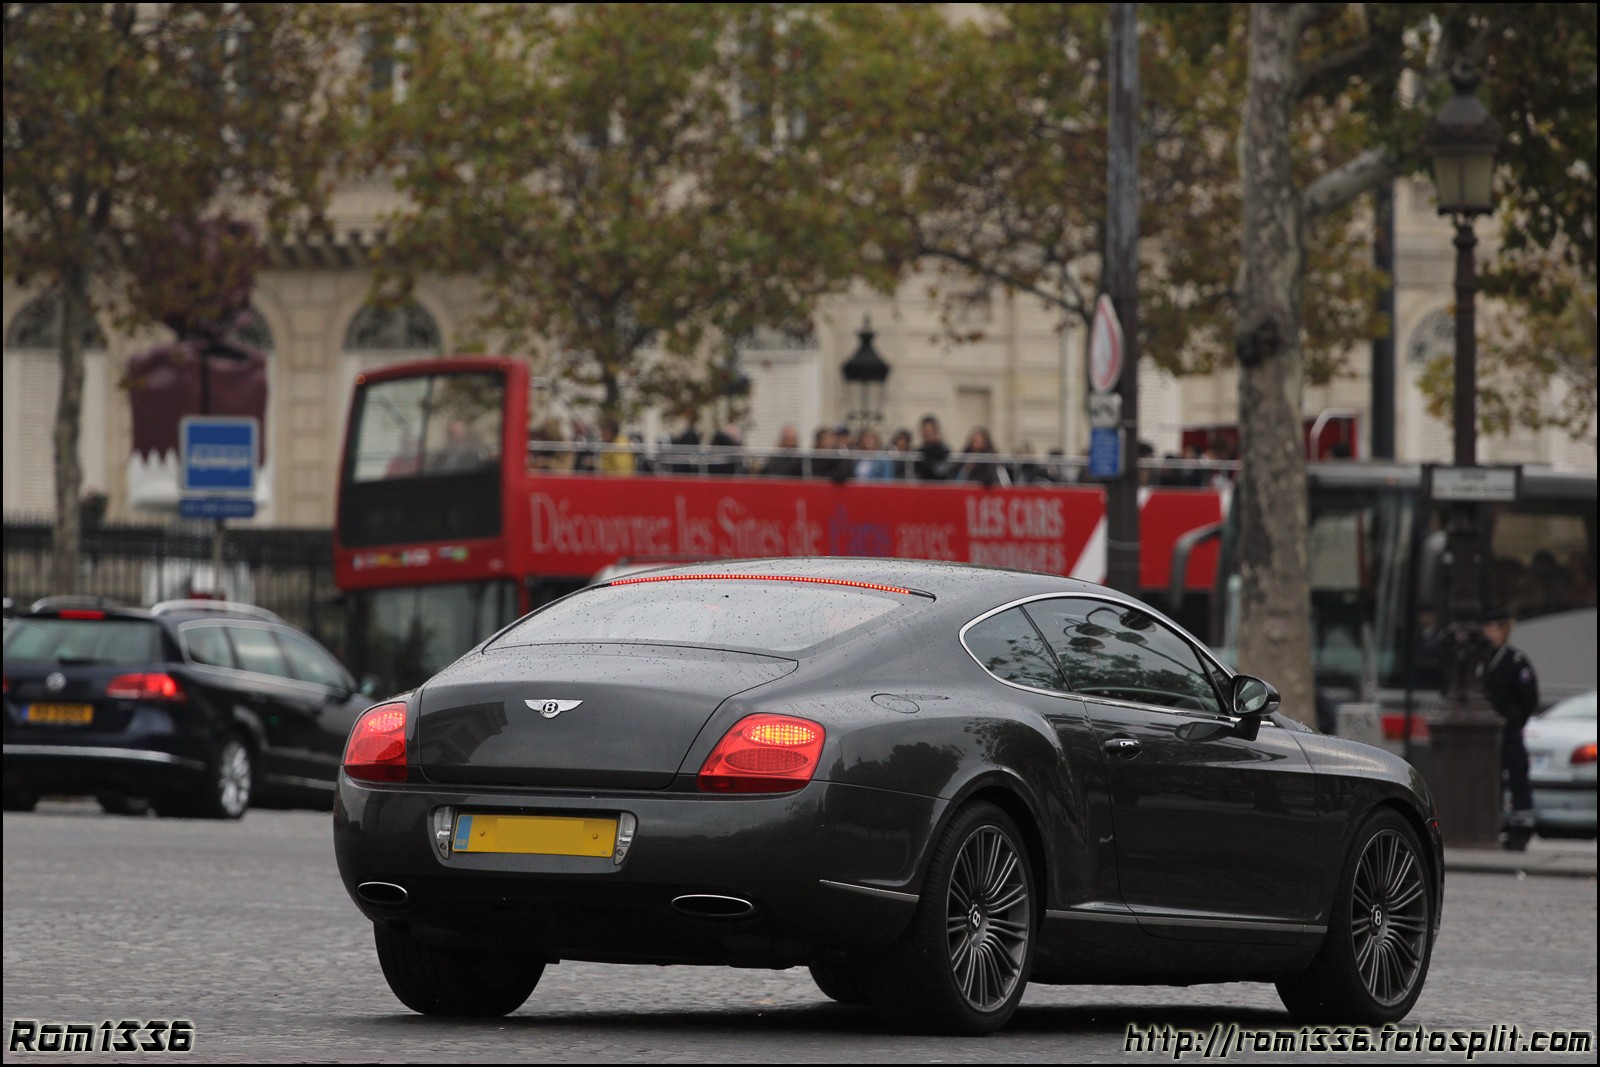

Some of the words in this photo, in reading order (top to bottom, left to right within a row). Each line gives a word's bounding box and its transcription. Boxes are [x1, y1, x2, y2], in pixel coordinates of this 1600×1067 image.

[787, 498, 822, 556] de
[966, 496, 1005, 538] LES
[1008, 497, 1063, 539] CARS
